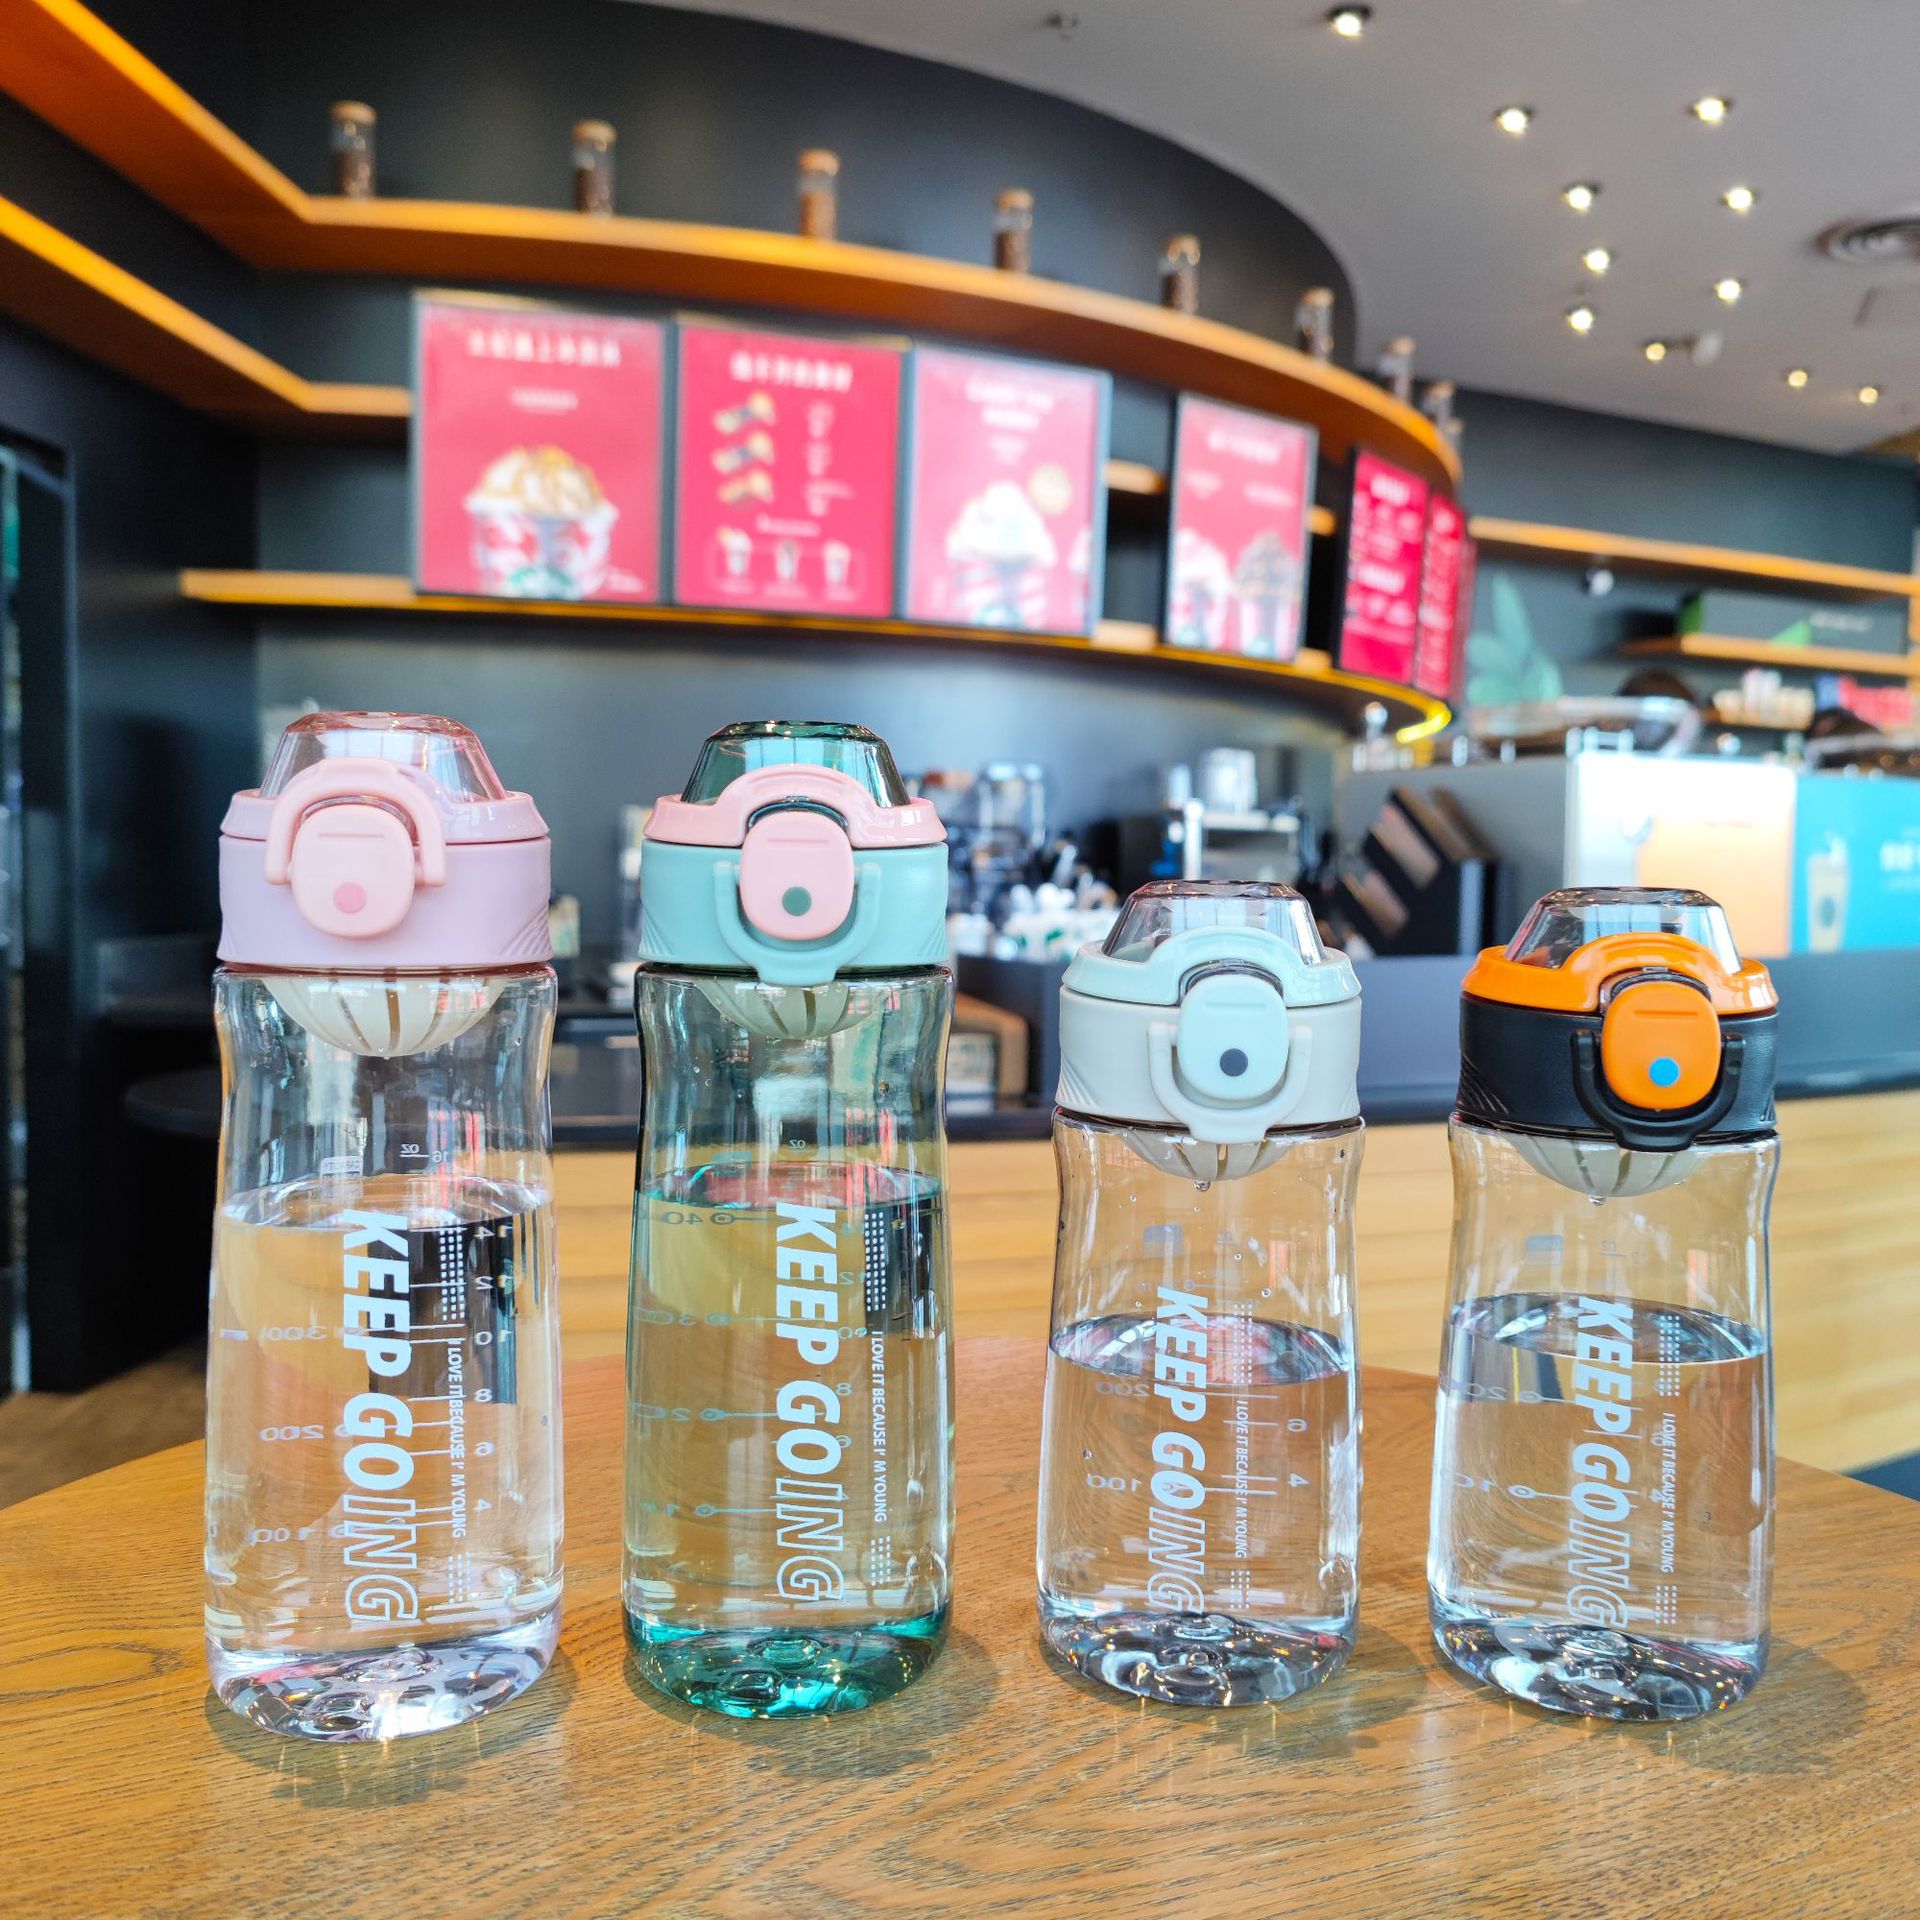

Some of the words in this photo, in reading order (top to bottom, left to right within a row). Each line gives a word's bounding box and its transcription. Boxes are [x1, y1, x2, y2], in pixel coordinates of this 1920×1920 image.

[343, 1209, 411, 1378] KEEP
[776, 1202, 839, 1366] KEEP
[447, 1348, 463, 1382] LOVE
[872, 1338, 884, 1371] LOVE
[872, 1372, 885, 1385] IT
[1154, 1286, 1209, 1422] KEEP
[1574, 1296, 1634, 1435] KEEP
[449, 1400, 465, 1459] BECAUSE
[872, 1387, 886, 1446] BECAUSE
[1236, 1404, 1248, 1434] LOVE
[1236, 1435, 1248, 1447] IT
[1663, 1418, 1676, 1447] LOVE
[1236, 1447, 1248, 1495] BECAUSE
[1663, 1448, 1676, 1460] IT
[343, 1392, 418, 1622] GOING
[776, 1380, 844, 1602] GOING
[874, 1474, 887, 1522] YOUNG
[1662, 1460, 1676, 1510] BECAUSE
[451, 1487, 466, 1538] YOUNG
[1147, 1431, 1206, 1615] GOING
[1567, 1442, 1631, 1629] GOING
[1235, 1518, 1248, 1559] YOUNG
[1661, 1533, 1675, 1573] YOUNG
